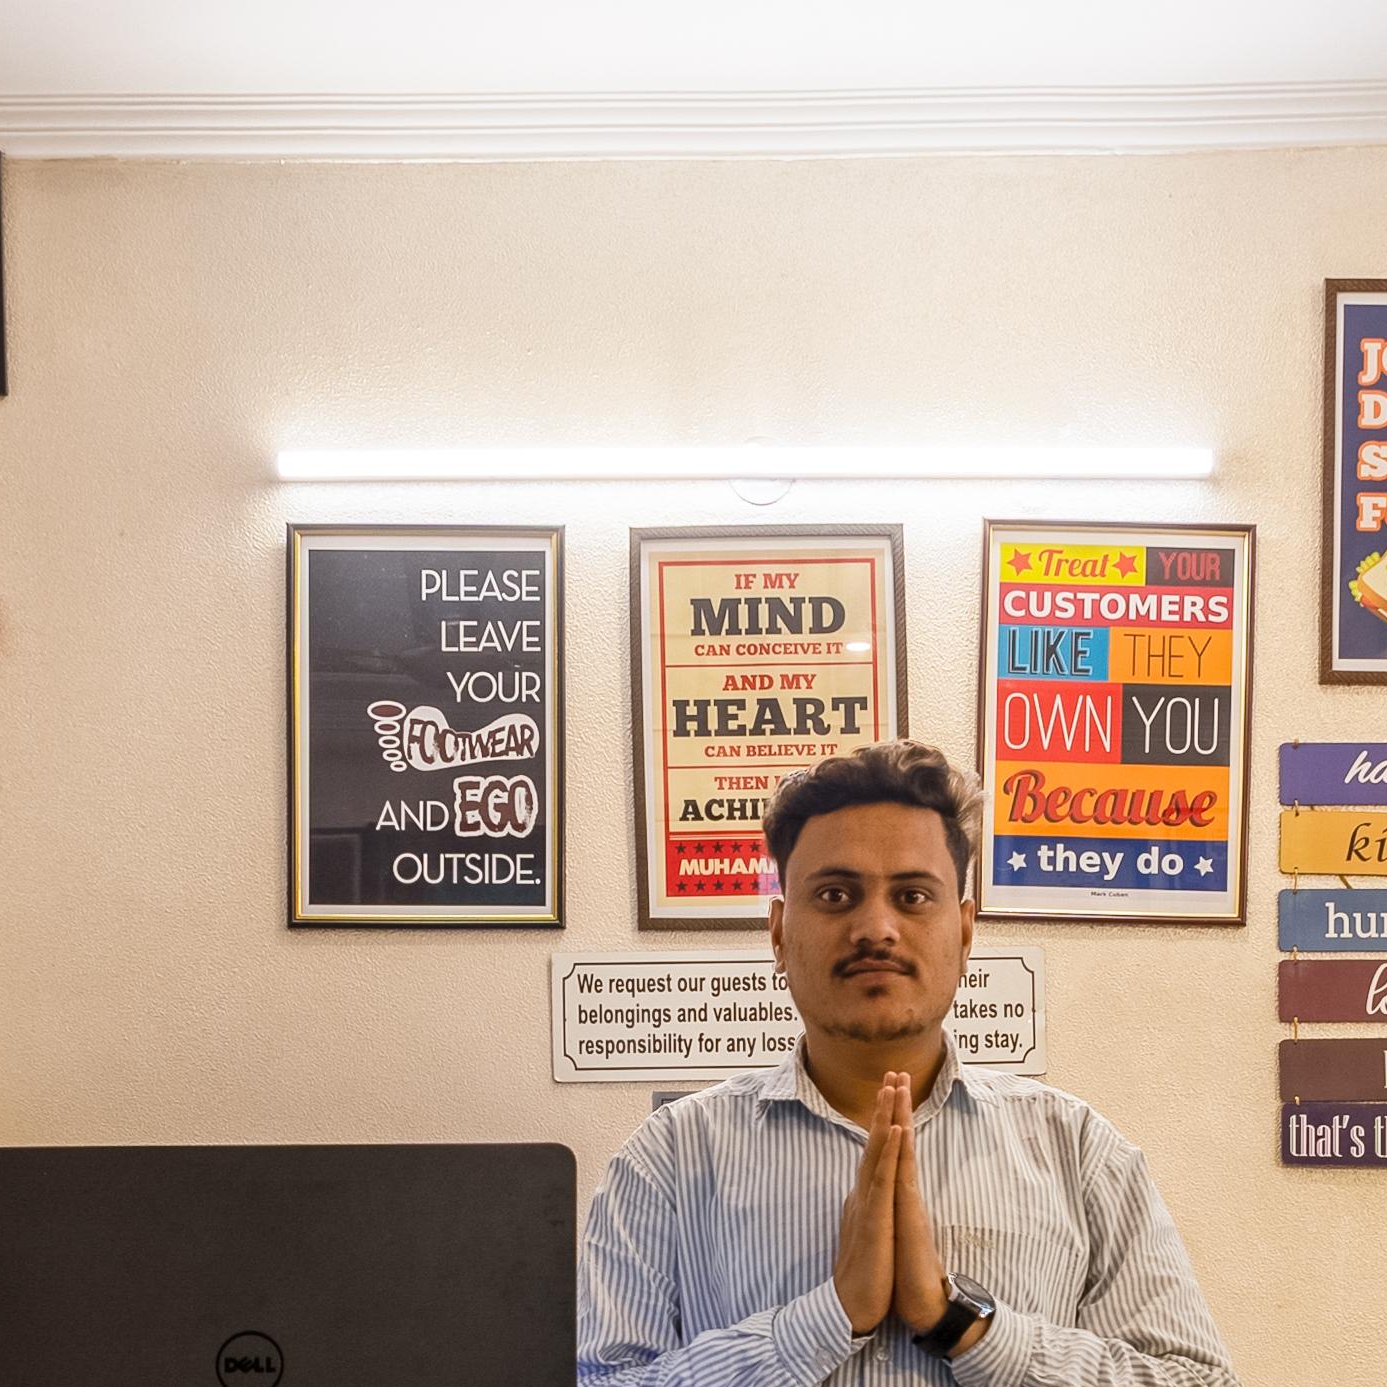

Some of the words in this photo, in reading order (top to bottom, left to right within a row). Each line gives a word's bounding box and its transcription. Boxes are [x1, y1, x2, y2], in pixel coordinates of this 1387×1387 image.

[1038, 549, 1112, 579] Treat
[1158, 551, 1221, 581] YOUR
[421, 569, 541, 602] PLEASE
[734, 573, 757, 590] IF
[762, 573, 800, 589] MY
[690, 596, 846, 637] MIND
[1004, 590, 1229, 623] CUSTOMERS
[441, 620, 541, 652] LEAVE
[694, 643, 732, 657] CAN
[735, 642, 822, 657] CONCEIVE
[826, 641, 843, 655] IT
[1006, 627, 1093, 677] LIKE
[1123, 633, 1213, 678] THEY
[446, 671, 541, 702] YOUR
[722, 675, 774, 691] AND
[779, 674, 817, 691] MY
[672, 696, 869, 738] HEART
[1004, 692, 1112, 754] OWN
[1132, 696, 1220, 755] YOU
[406, 717, 535, 764] FOOTWEAR
[704, 745, 742, 758] CAN
[745, 744, 818, 758] BELIEVE
[821, 743, 838, 756] IT
[714, 776, 769, 790] THEN
[1002, 768, 1219, 828] Because
[375, 801, 449, 831] AND
[455, 777, 535, 835] EGO
[679, 798, 770, 822] ACHI
[392, 853, 541, 885] OUTSIDE.
[1037, 844, 1124, 880] they
[1136, 847, 1184, 876] do
[577, 973, 604, 994] We
[608, 973, 672, 998] request
[677, 977, 707, 993] our
[710, 974, 768, 997] guests
[772, 973, 788, 991] to
[958, 968, 990, 988] heir
[578, 1004, 672, 1029] belongings
[677, 1003, 707, 1023] and
[713, 1002, 798, 1022] valuables.
[953, 998, 998, 1019] takes
[1004, 1003, 1024, 1018] no
[578, 1033, 693, 1056] responsibility
[697, 1034, 721, 1053] for
[726, 1037, 757, 1057] any
[761, 1032, 795, 1052] loss
[984, 1029, 1023, 1054] stay.
[1289, 1113, 1365, 1159] that's
[224, 1356, 277, 1374] DELL
